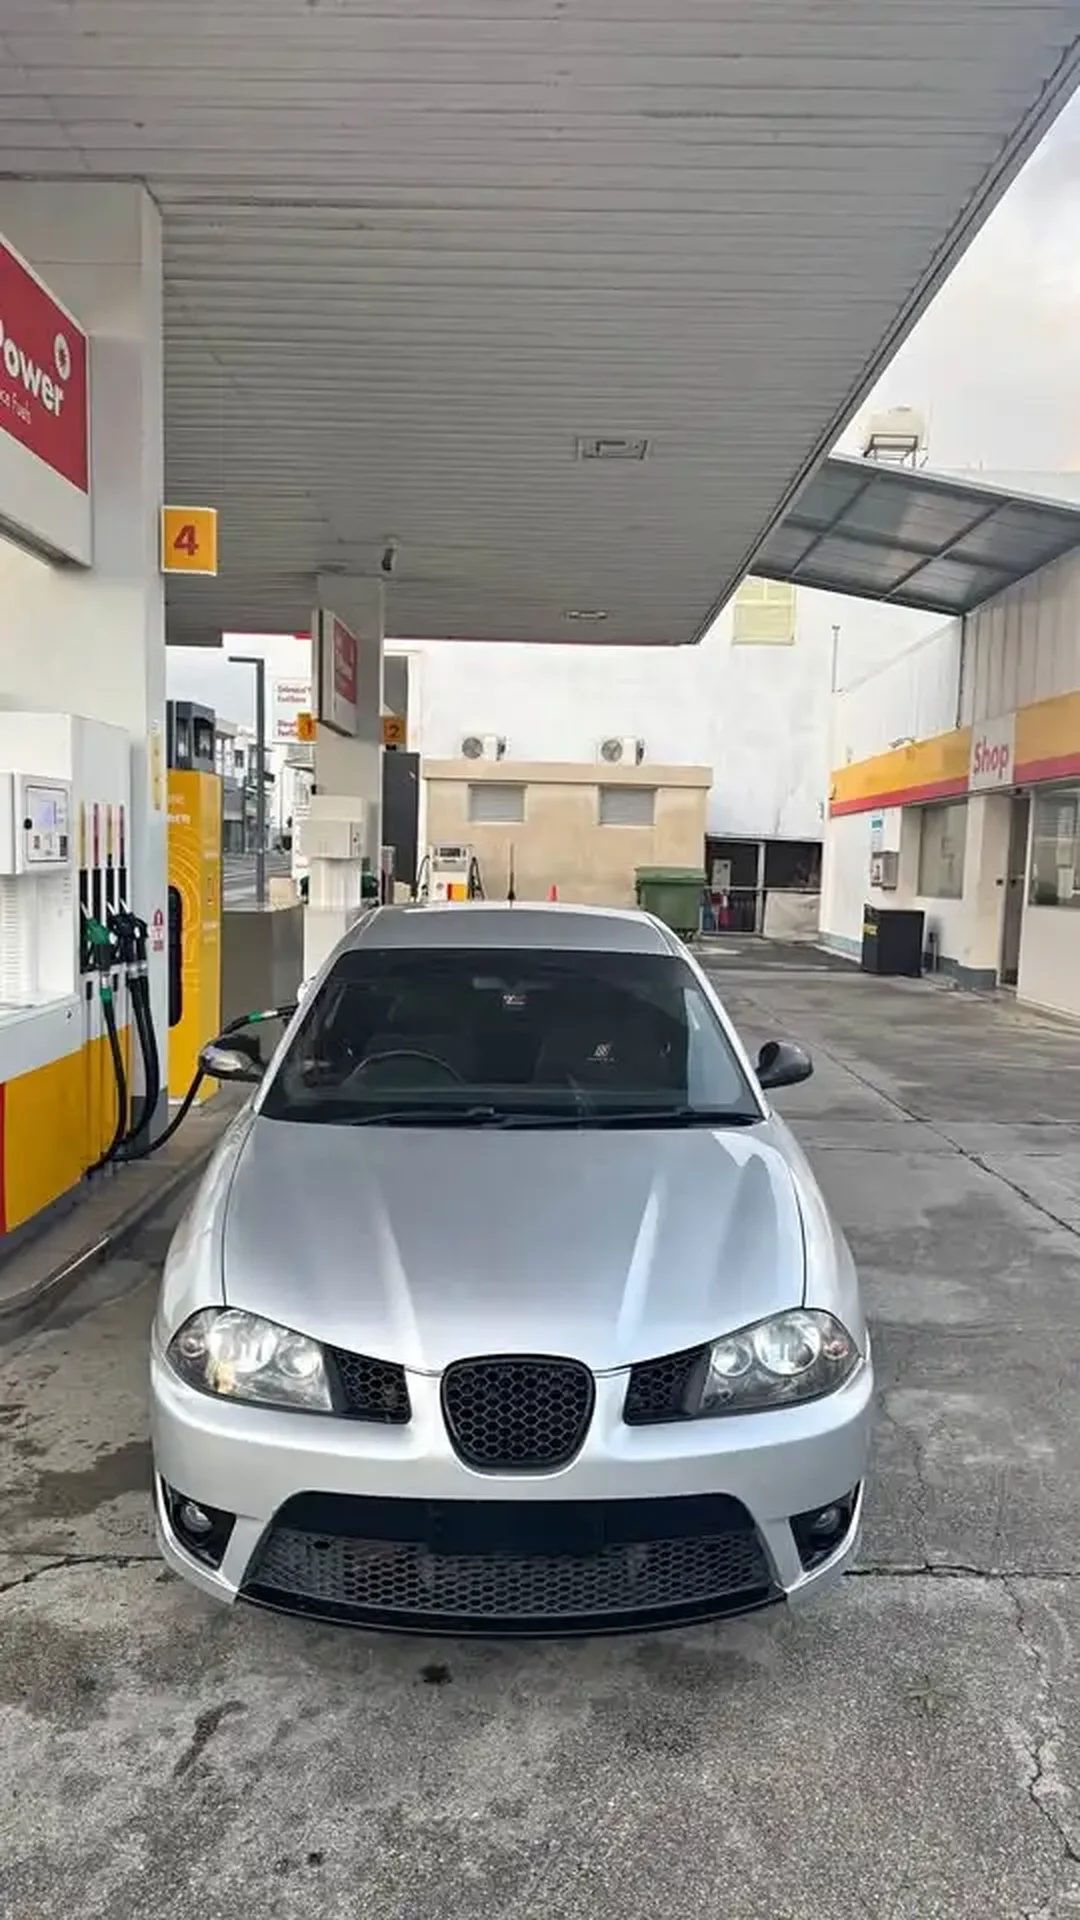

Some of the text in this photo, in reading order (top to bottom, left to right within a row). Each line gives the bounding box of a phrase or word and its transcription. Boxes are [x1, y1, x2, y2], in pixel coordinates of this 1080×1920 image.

[0, 319, 64, 417] ower
[173, 524, 199, 556] 4
[387, 723, 400, 738] 2
[974, 735, 1009, 780] Shop
